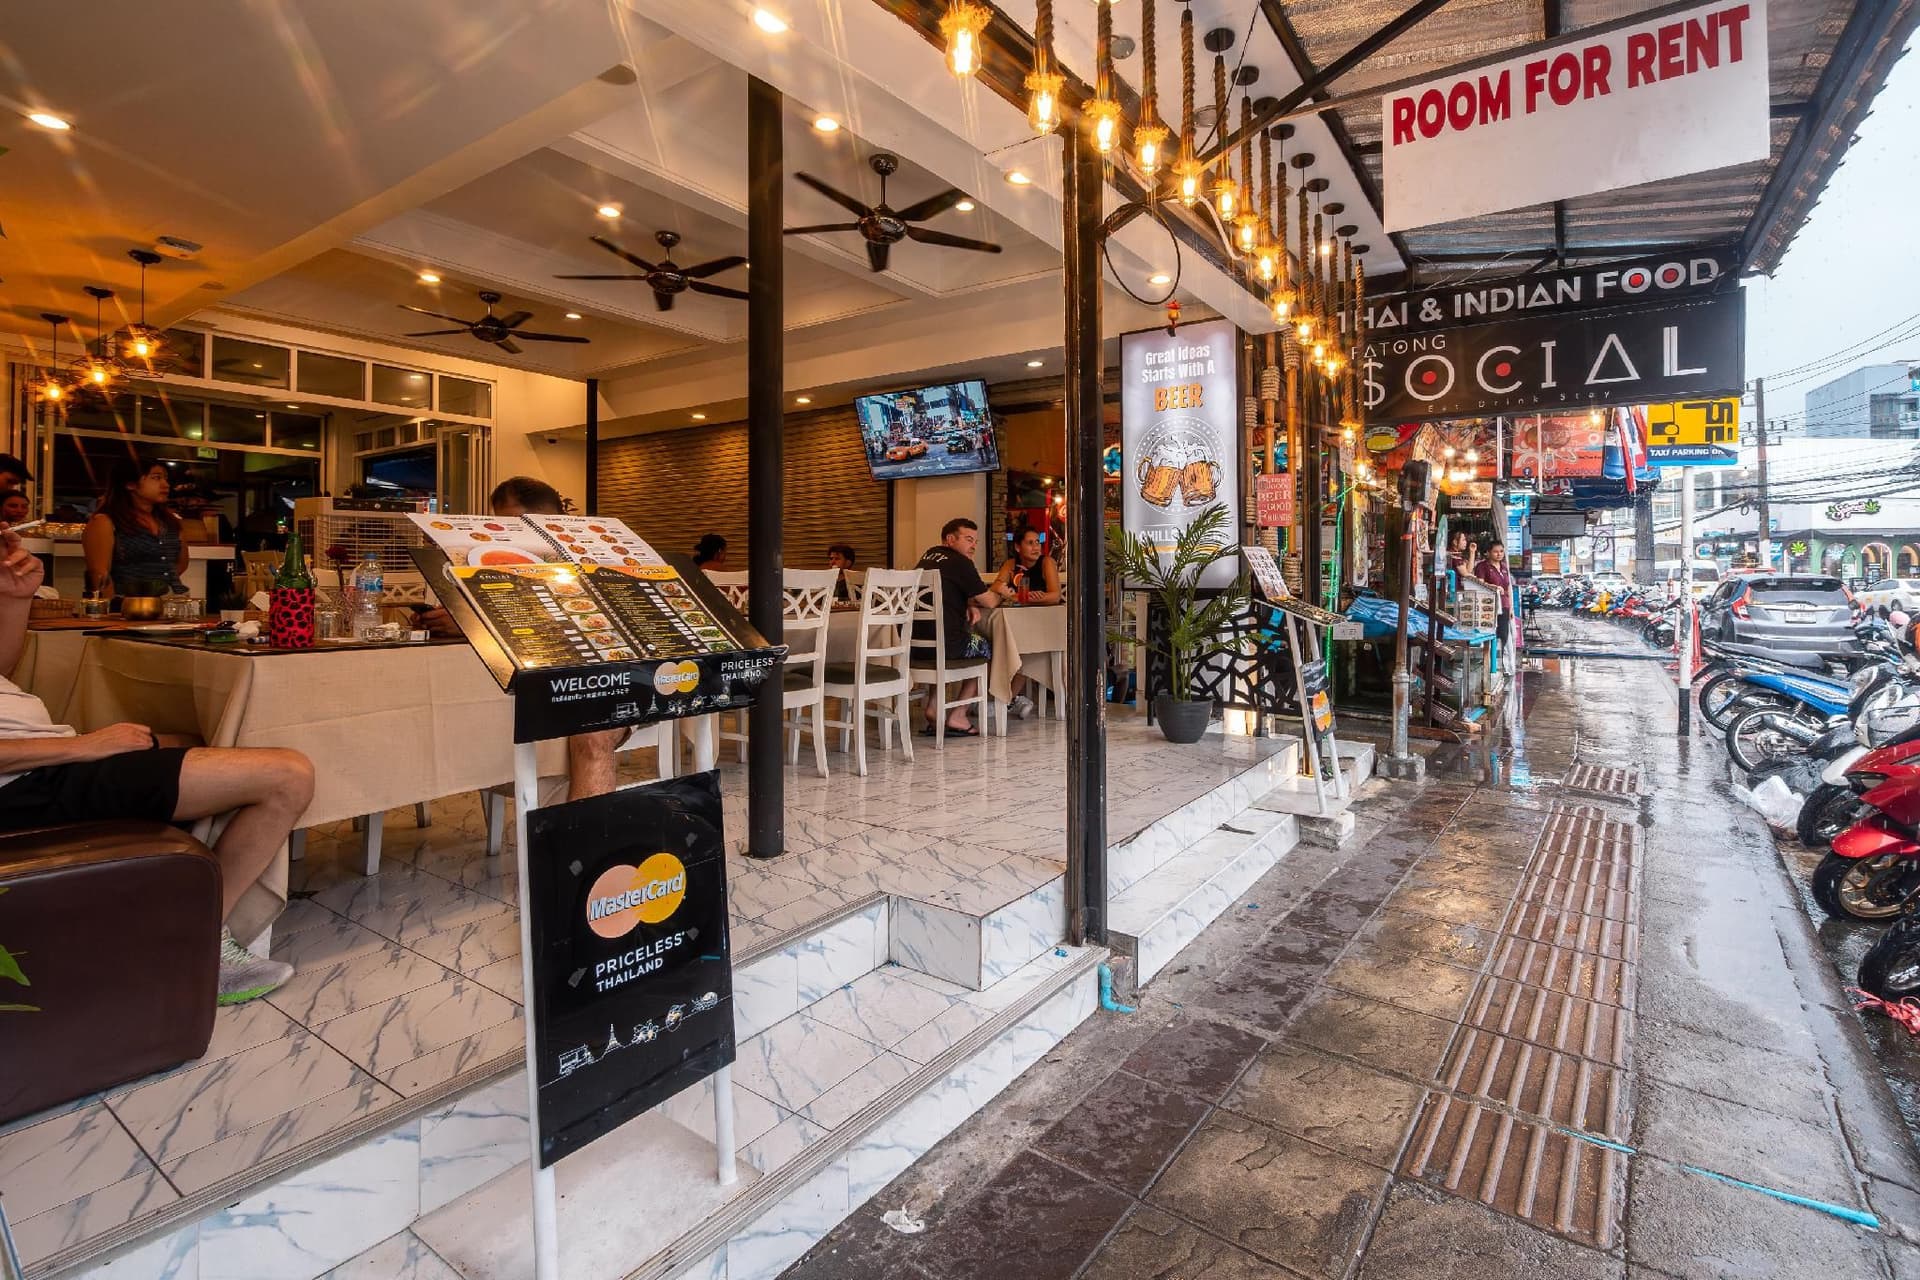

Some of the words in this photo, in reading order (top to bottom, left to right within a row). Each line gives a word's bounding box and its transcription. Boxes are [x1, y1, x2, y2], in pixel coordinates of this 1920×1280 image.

[1393, 69, 1510, 146] ROOM
[1525, 45, 1612, 114] FOR
[1627, 4, 1750, 88] RENT
[1419, 298, 1443, 322] &
[1454, 275, 1581, 318] INDIAN
[1596, 257, 1720, 299] FOOD
[1145, 348, 1175, 366] Great
[1178, 345, 1210, 361] Ideas
[1142, 366, 1175, 383] Starts
[1178, 361, 1204, 378] With
[1207, 360, 1215, 374] A
[1154, 382, 1204, 412] BEER
[1650, 448, 1670, 457] TAXI
[1672, 448, 1709, 456] PARKING
[721, 658, 774, 671] PRICELESS
[721, 670, 761, 681] THAILAND
[550, 672, 631, 693] WELCOME
[590, 872, 684, 921] MasterCard
[595, 932, 683, 978] PRICELESS
[596, 957, 663, 993] THAILAND
